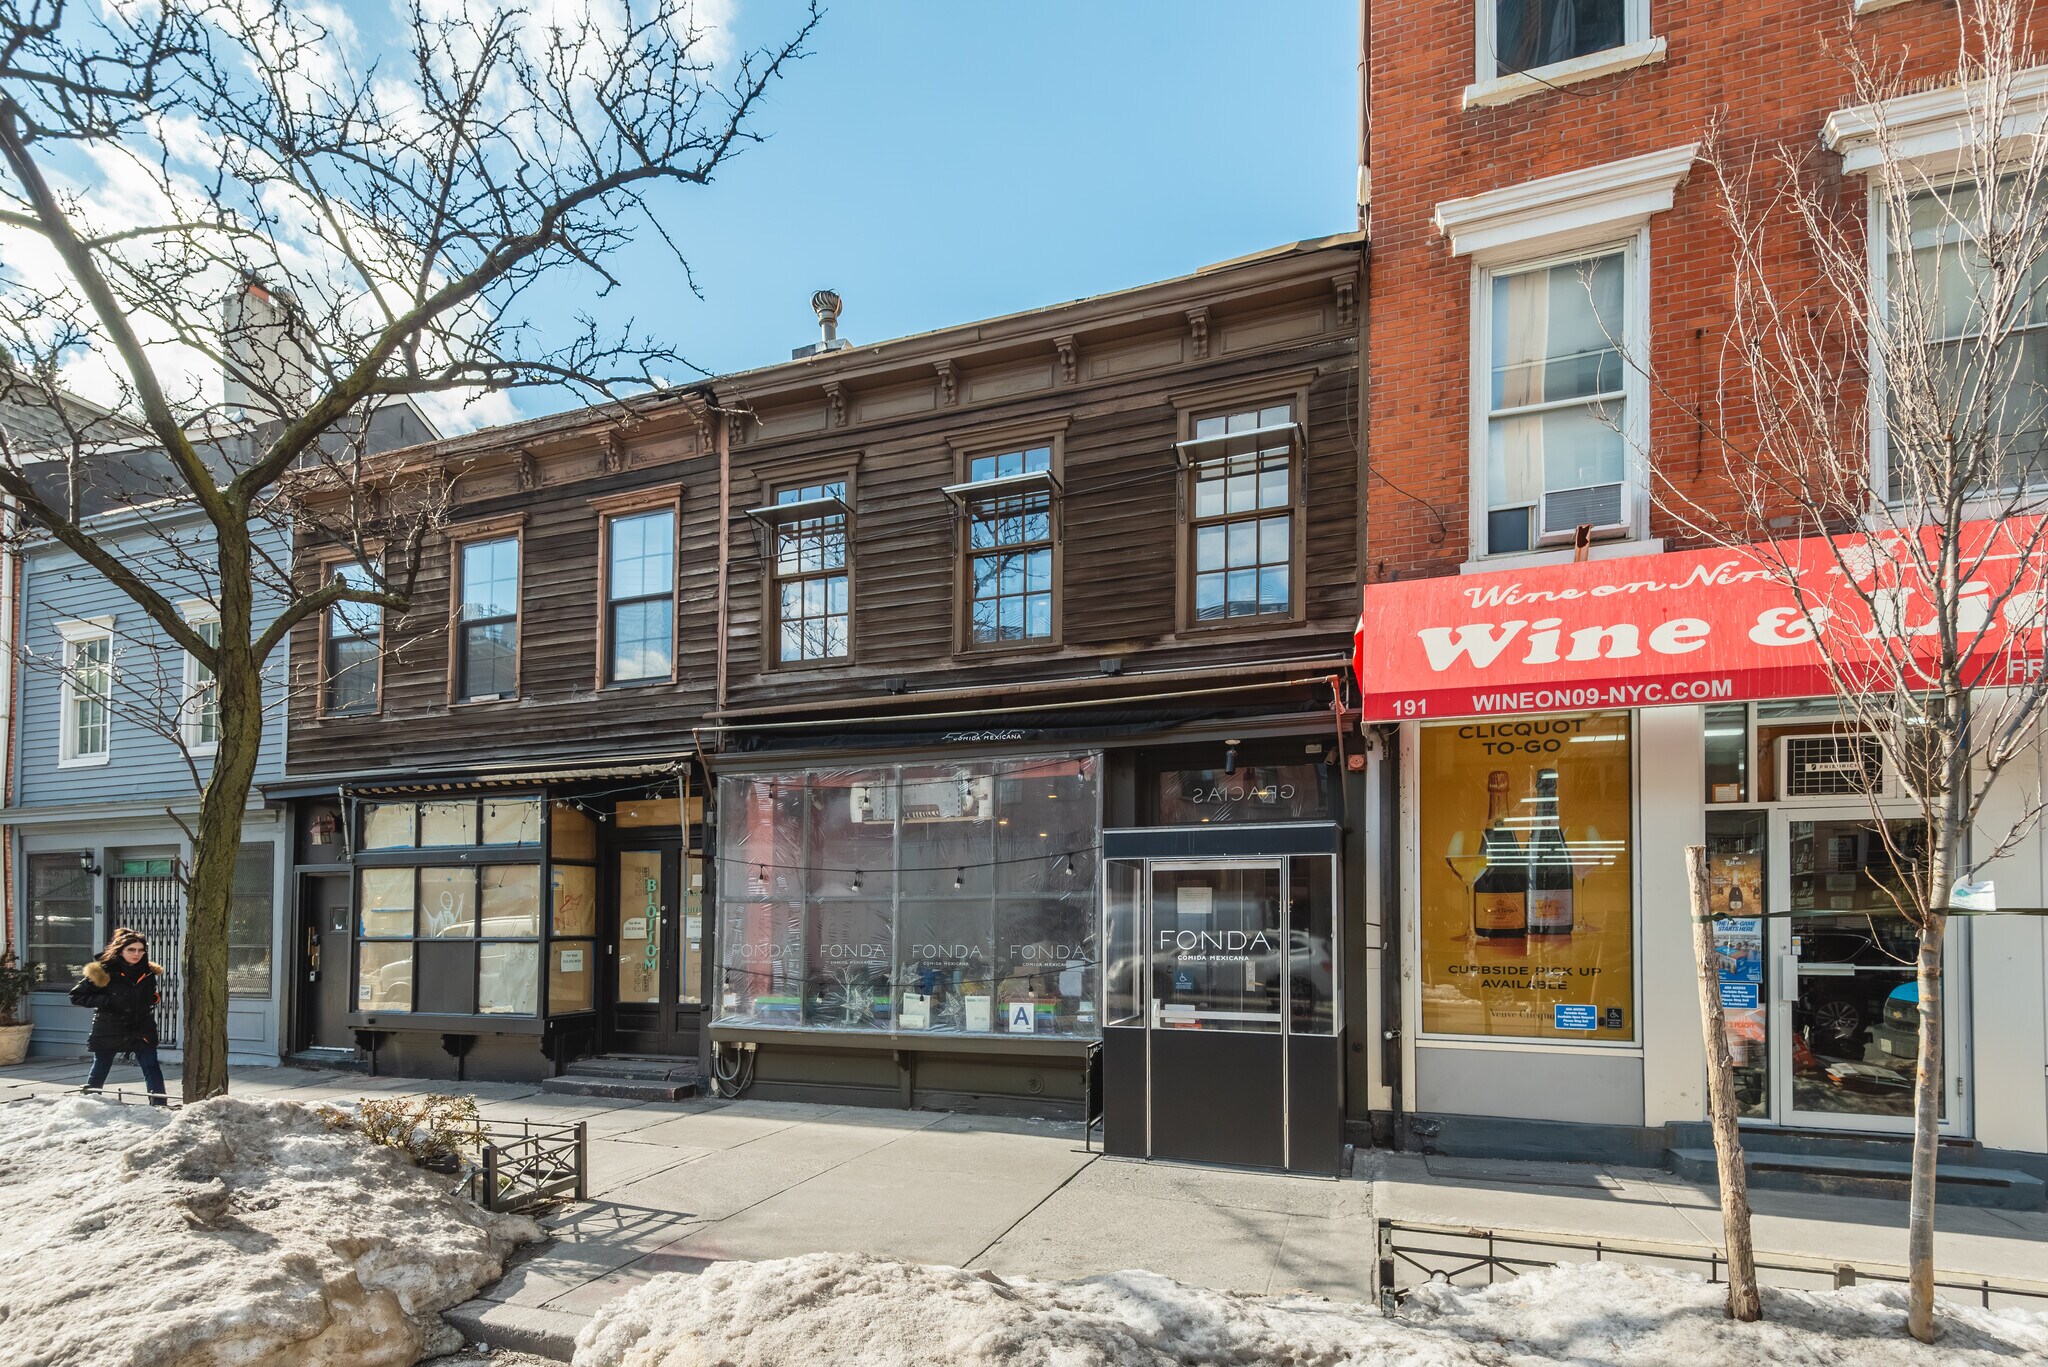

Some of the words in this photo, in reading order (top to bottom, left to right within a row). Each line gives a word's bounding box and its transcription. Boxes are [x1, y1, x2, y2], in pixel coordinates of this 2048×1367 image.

[1463, 583, 1588, 609] Wine
[1590, 579, 1667, 598] on
[1417, 617, 1711, 672] Wine
[1748, 607, 1834, 647] &
[1392, 698, 1427, 717] 191
[1472, 679, 1732, 713] WINEON09-NYC.COM
[983, 733, 1022, 741] MEXICANA
[1458, 719, 1586, 739] CLICQUOT
[1482, 739, 1561, 756] TO-GO
[1160, 930, 1271, 951] FONDA
[732, 943, 793, 958] FONDA
[820, 943, 887, 958] FONDA
[912, 944, 983, 959] FONDA
[1010, 944, 1086, 960] FONDA
[1448, 965, 1529, 976] CURBSIDE
[1536, 966, 1573, 977] PICK
[1579, 967, 1602, 977] UP
[1481, 979, 1568, 990] AVAILABLE
[1013, 1006, 1030, 1026] A
[1490, 1008, 1517, 1018] Veuve
[1519, 1009, 1555, 1021] Clicquo
